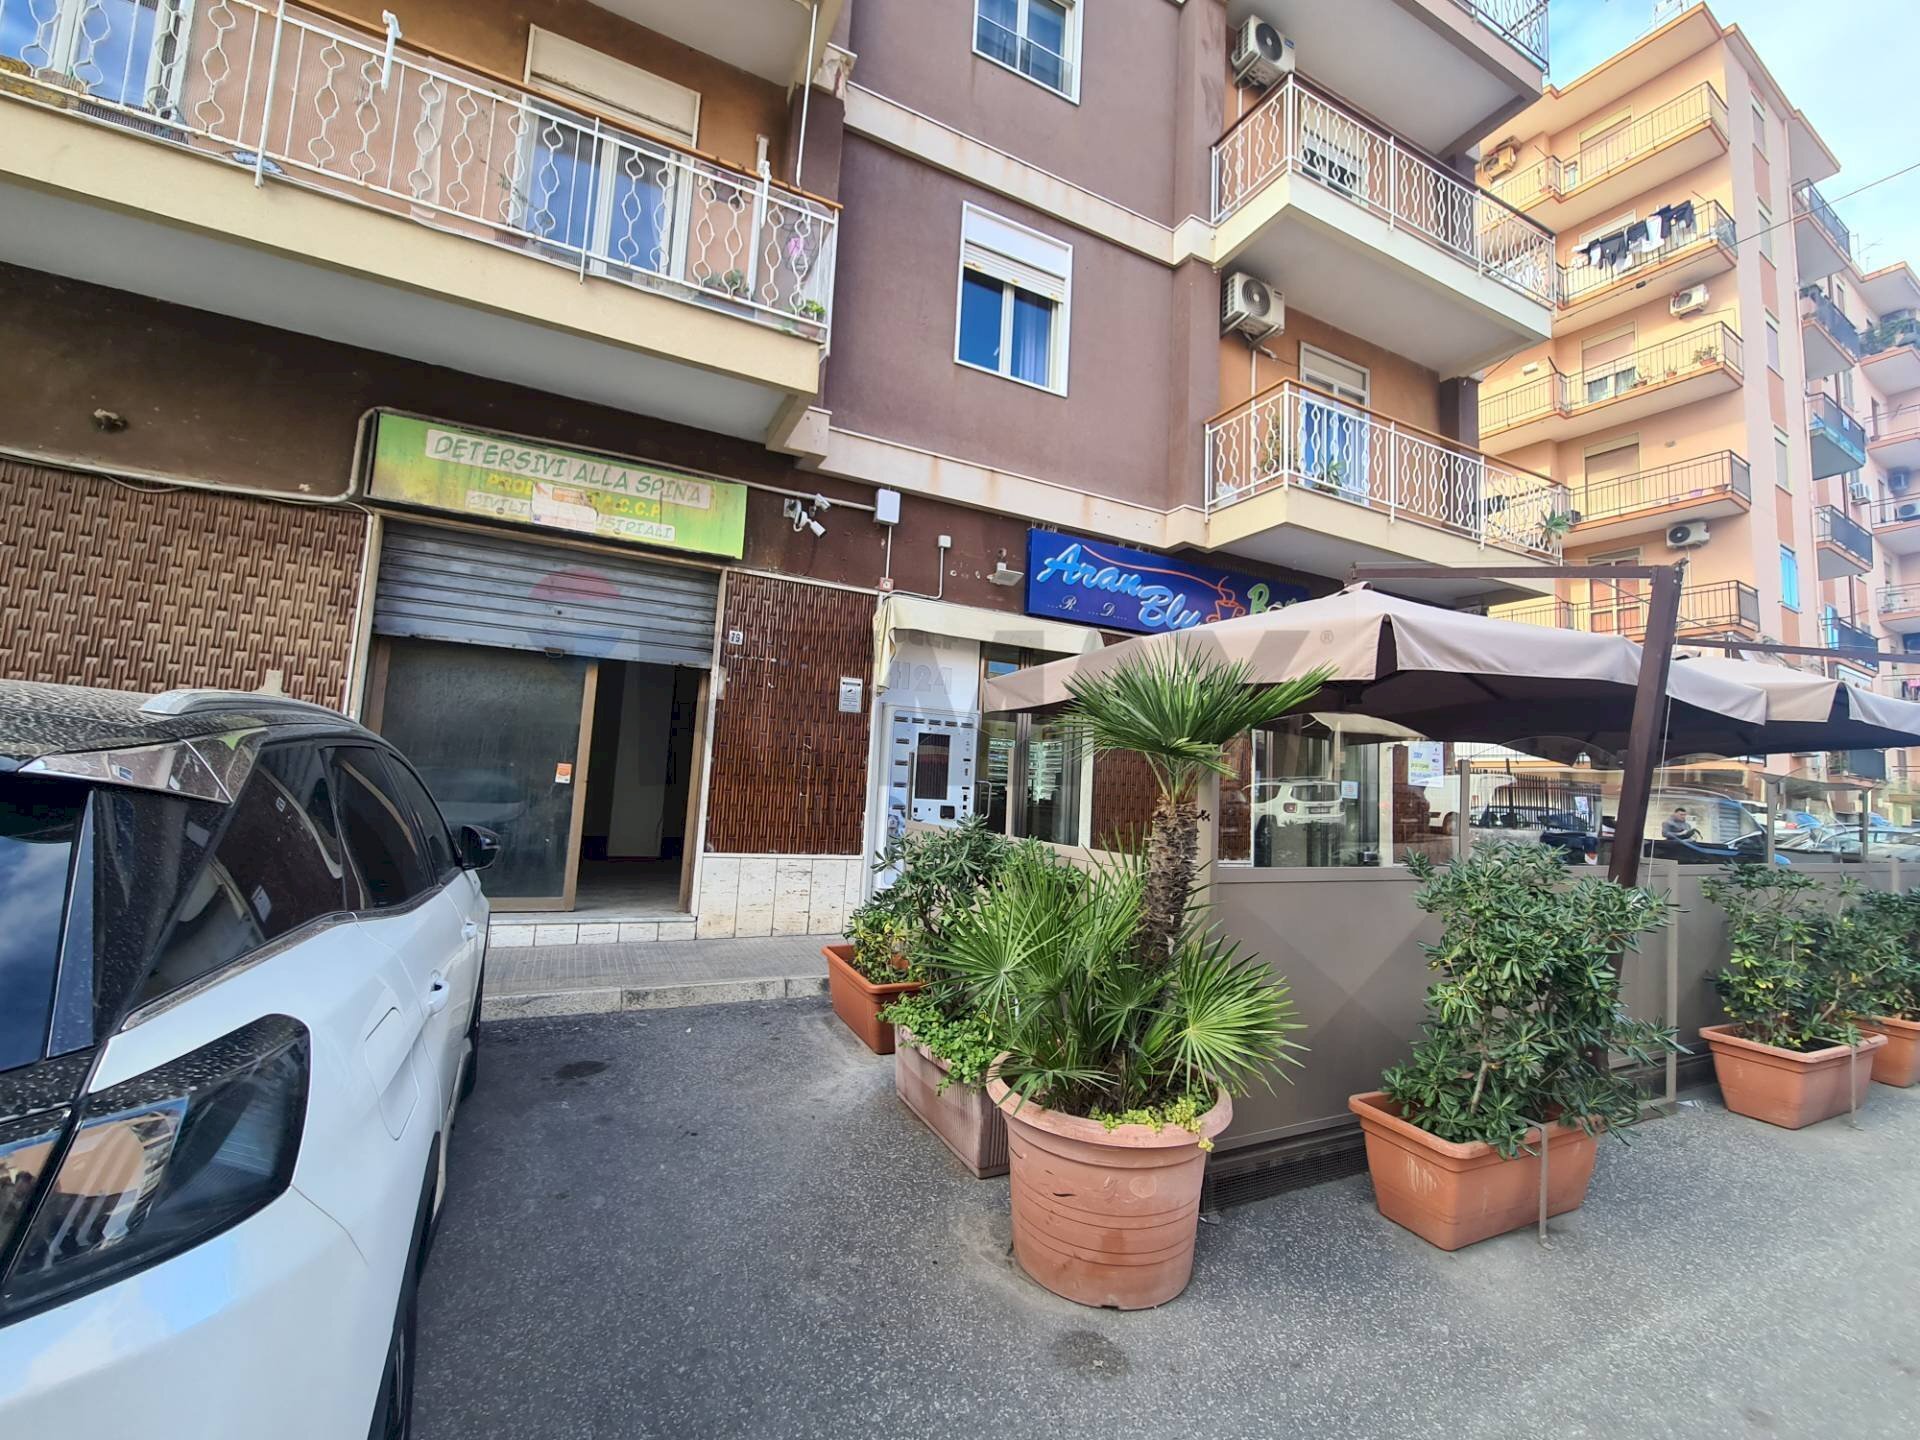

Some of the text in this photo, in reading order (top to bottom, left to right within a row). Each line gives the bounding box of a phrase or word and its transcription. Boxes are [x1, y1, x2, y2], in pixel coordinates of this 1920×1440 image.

[434, 436, 701, 504] DETERSIVI ALLA SPINA
[1036, 543, 1142, 597] Aran
[1137, 585, 1201, 629] Blu
